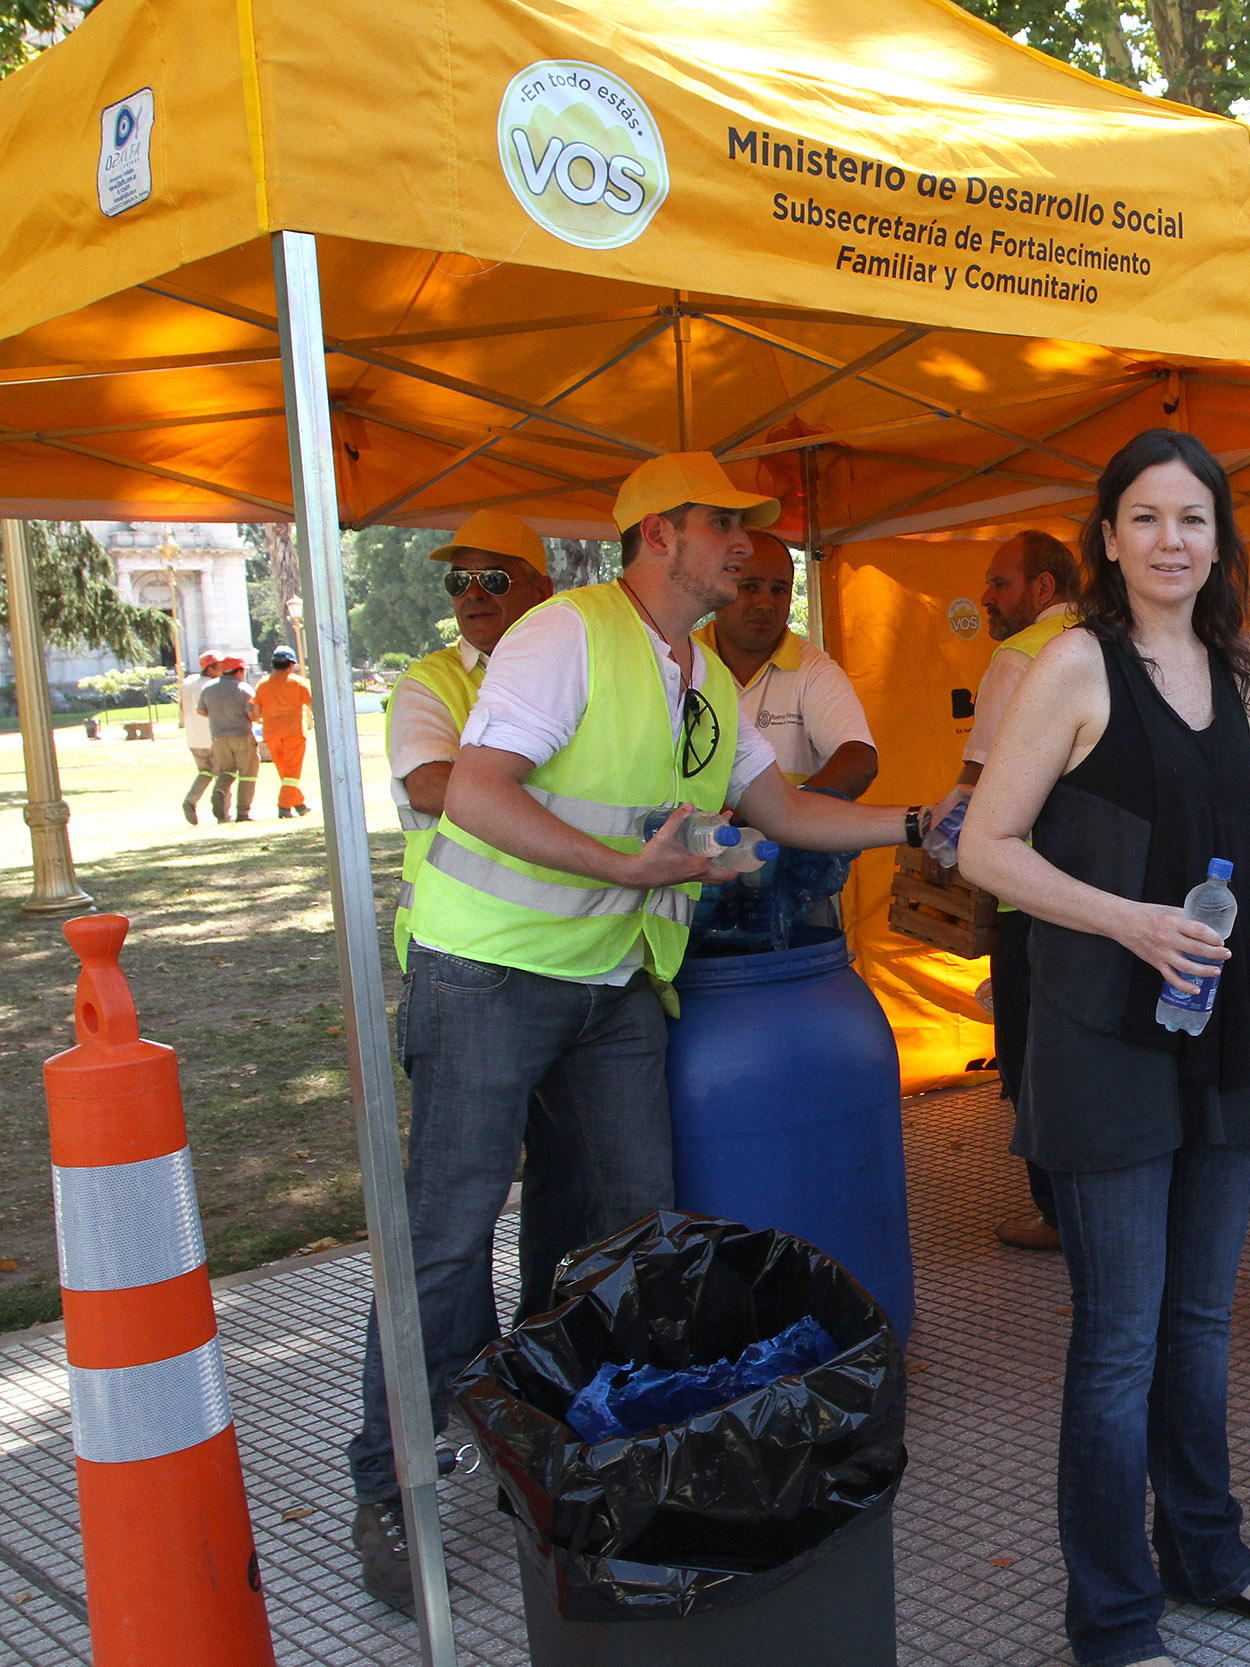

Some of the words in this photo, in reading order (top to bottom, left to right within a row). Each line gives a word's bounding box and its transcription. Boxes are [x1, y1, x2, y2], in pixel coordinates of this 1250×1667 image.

[548, 73, 591, 91] todo
[598, 86, 640, 129] estás
[512, 128, 645, 215] VOS
[727, 126, 905, 191] Ministerio
[917, 173, 957, 201] de
[966, 176, 1104, 226] Desarrollo
[1112, 202, 1184, 240] Social
[773, 193, 947, 247] Subsecretaría
[954, 225, 982, 252] de
[990, 231, 1151, 276] Fortalecimiento
[835, 246, 937, 284] Familiar
[944, 268, 956, 290] y
[965, 265, 1098, 303] Comunitario
[950, 615, 978, 632] VOS
